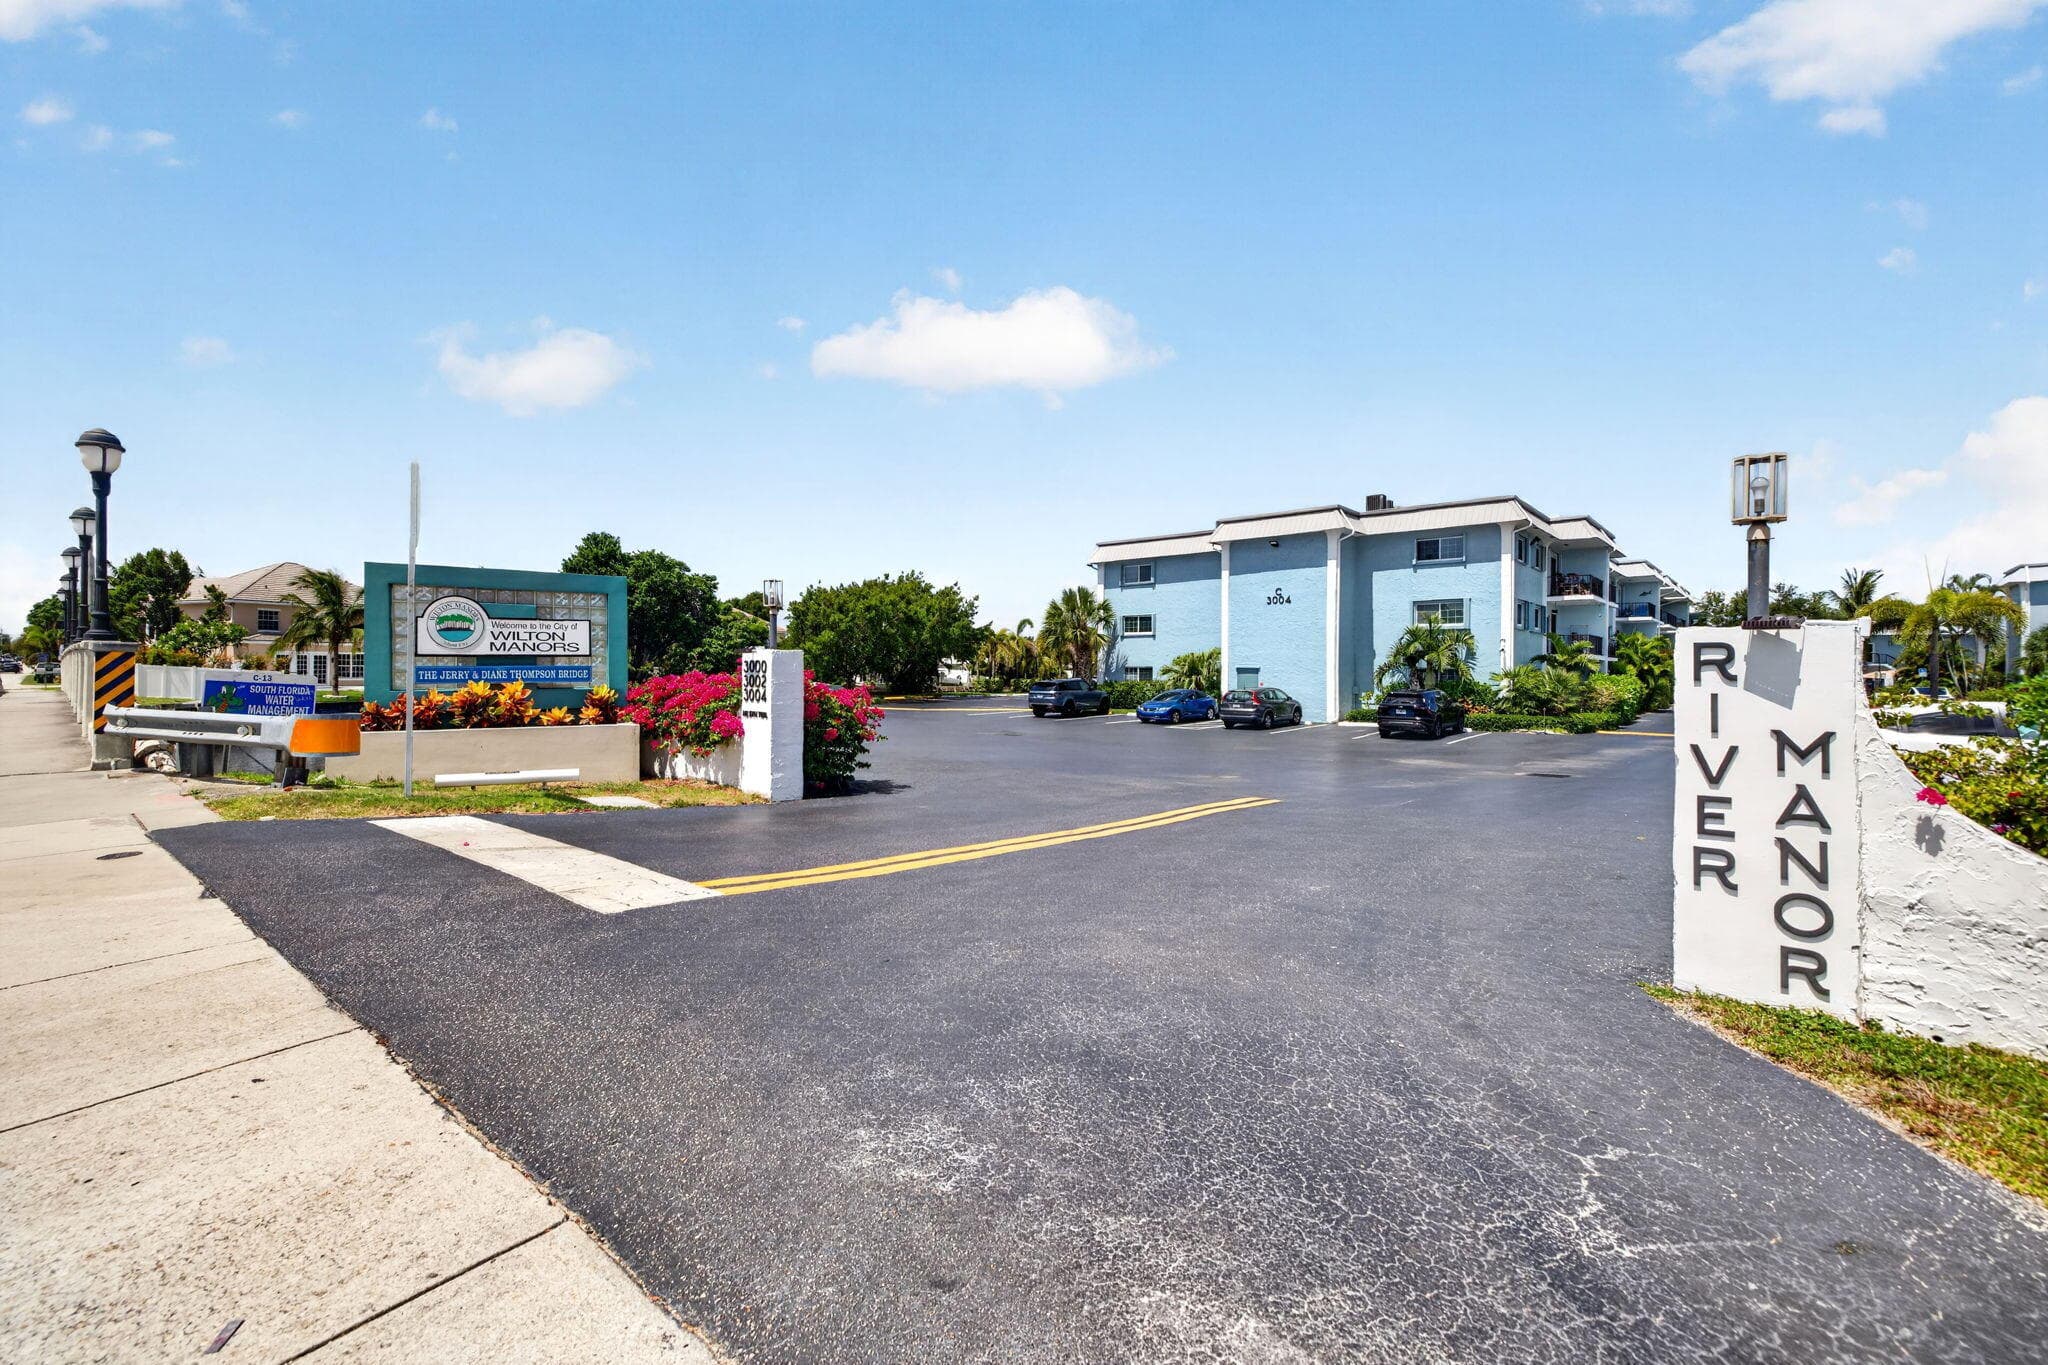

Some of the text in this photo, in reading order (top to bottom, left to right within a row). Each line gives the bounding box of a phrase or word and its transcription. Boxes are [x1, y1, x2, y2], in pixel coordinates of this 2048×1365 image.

[1275, 587, 1282, 596] C
[1266, 595, 1292, 605] 3004
[491, 621, 578, 632] Welcome to the City of
[490, 630, 566, 641] WILTON
[490, 642, 579, 652] MANORS
[743, 660, 767, 673] 3000
[418, 669, 589, 680] THE JERRY & DIANE THOMPSON BRIDGE
[743, 674, 767, 688] 3002
[250, 685, 310, 695] SOUTH FLORIDA
[265, 694, 294, 706] WATER
[743, 688, 767, 704] 3004
[248, 704, 310, 716] MANAGEMENT
[1689, 642, 1739, 892] RIVER
[1770, 729, 1837, 999] MANOR
